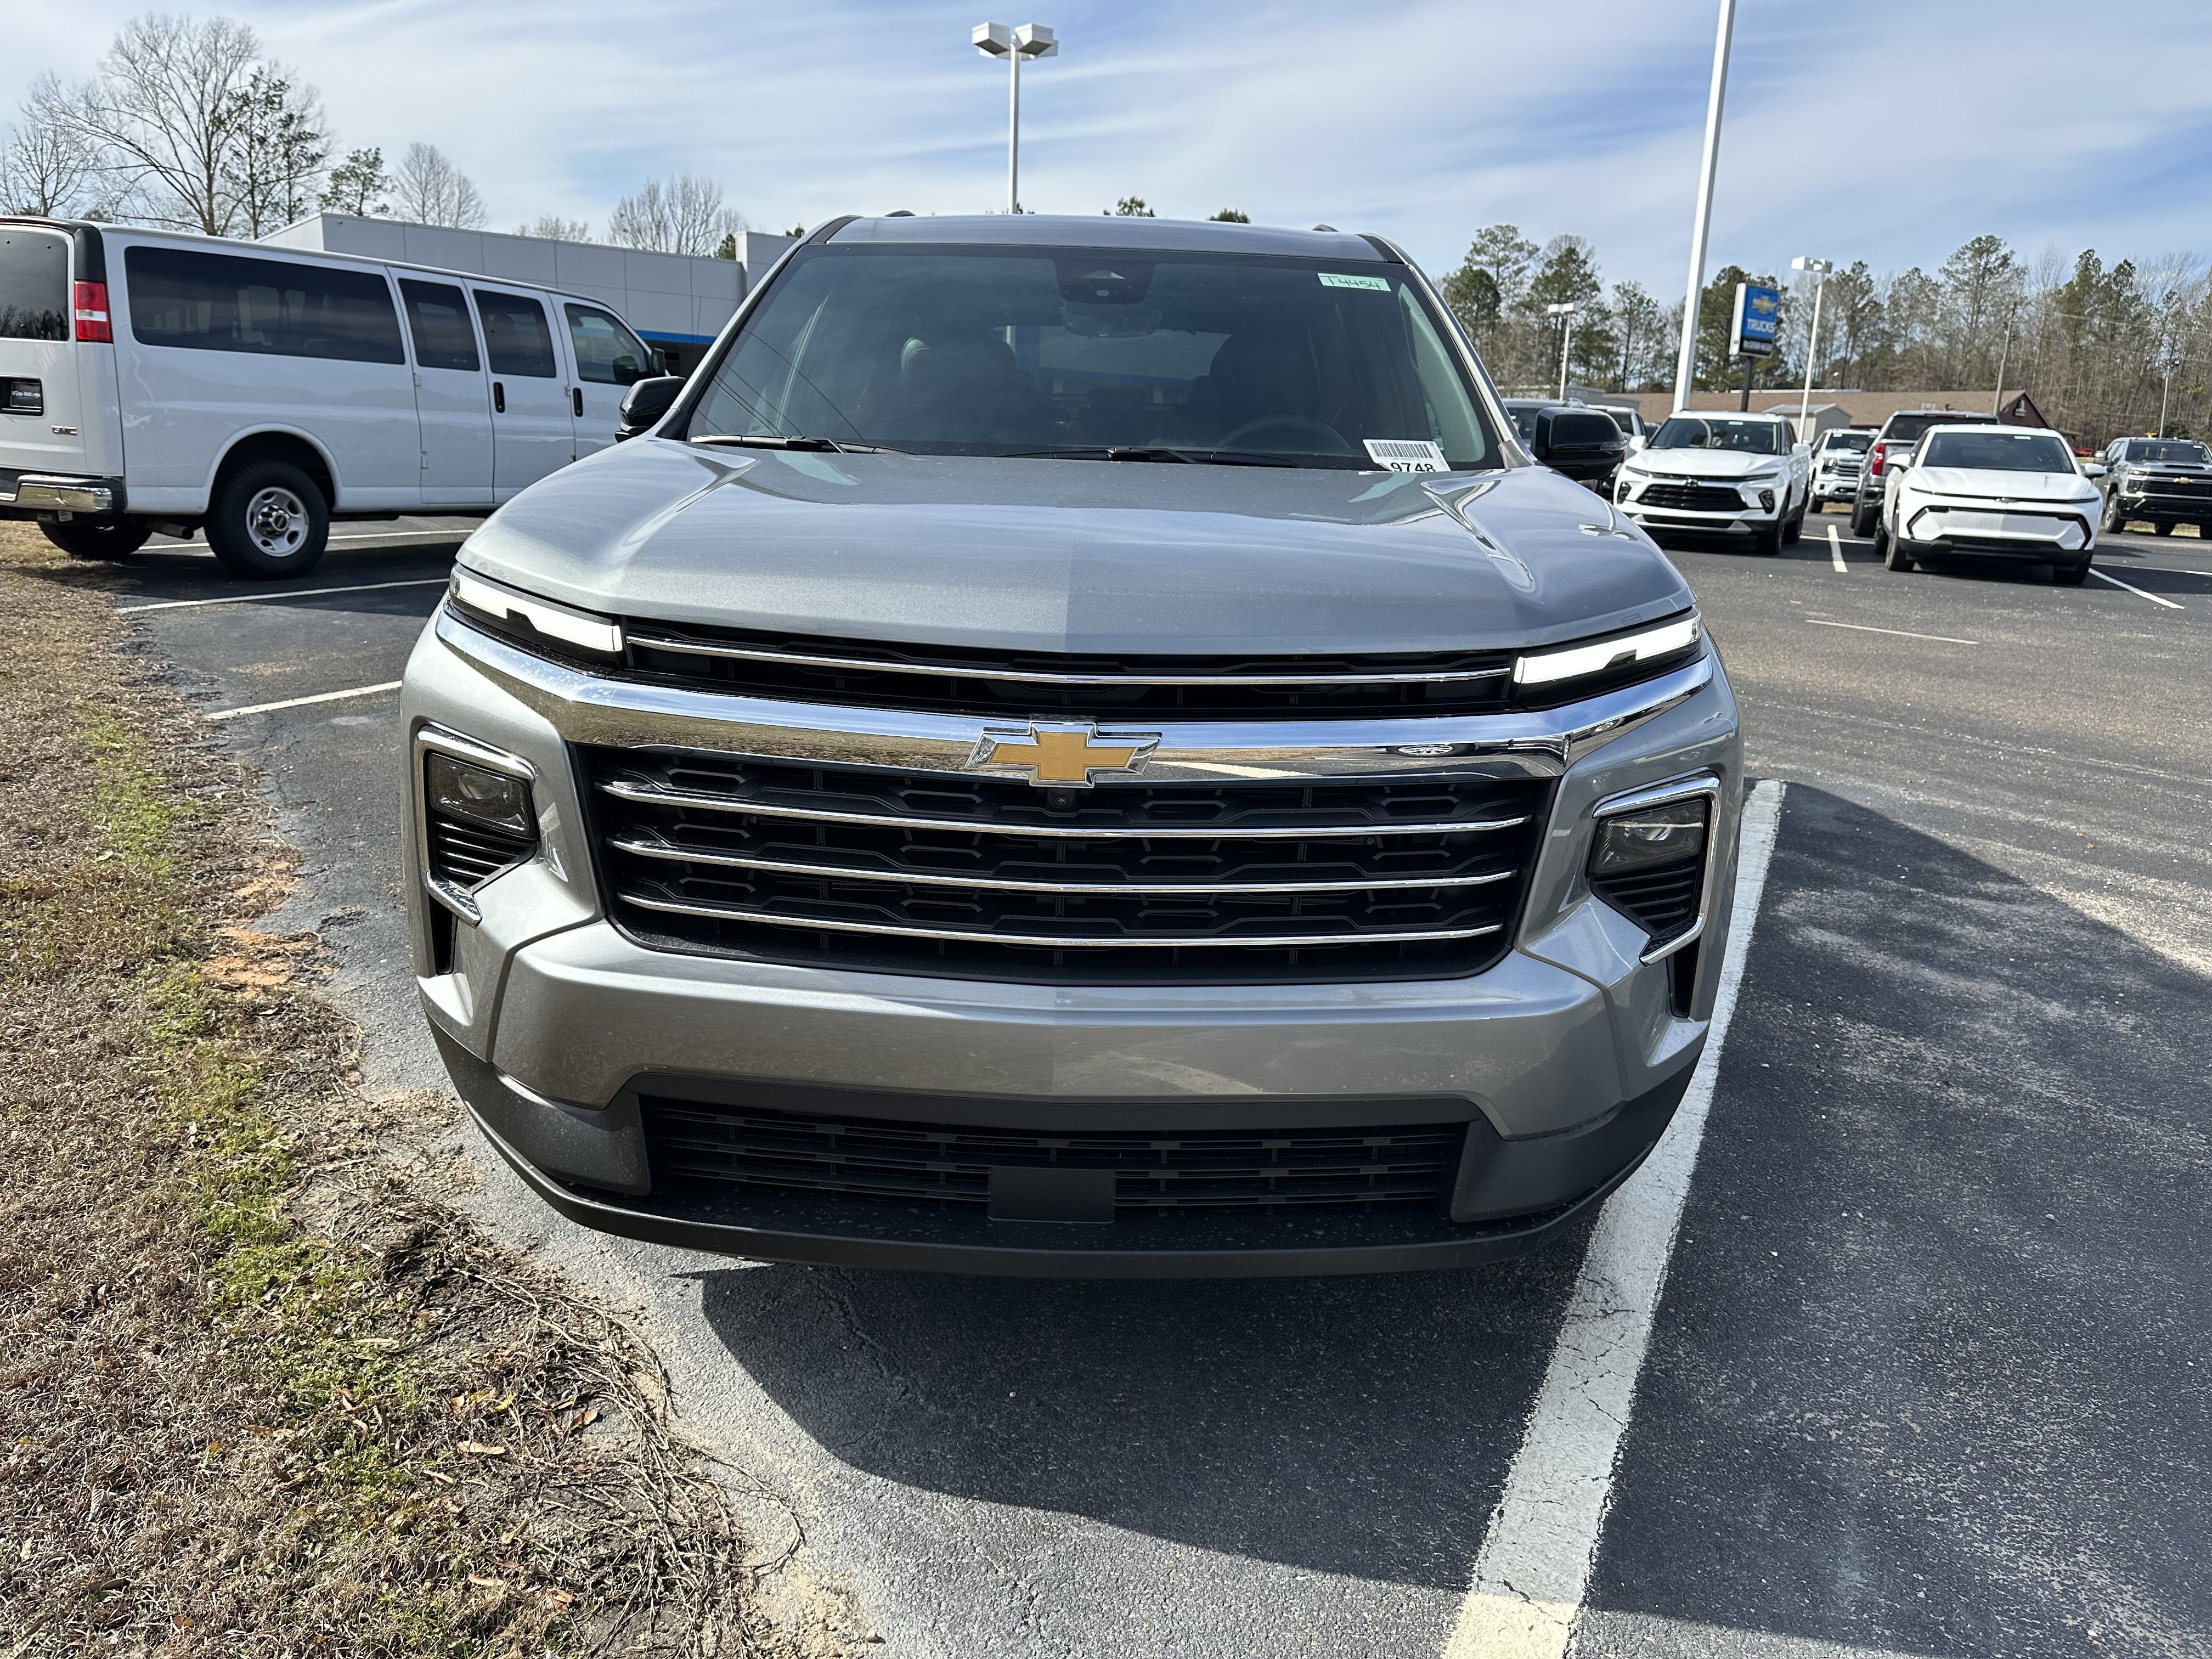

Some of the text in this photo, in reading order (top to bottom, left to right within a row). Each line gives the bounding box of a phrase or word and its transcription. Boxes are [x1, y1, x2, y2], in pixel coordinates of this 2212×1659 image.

[1319, 275, 1381, 290] T4454
[1746, 318, 1775, 333] TRUCKS
[52, 425, 77, 435] GMC
[1390, 462, 1436, 472] 9748
